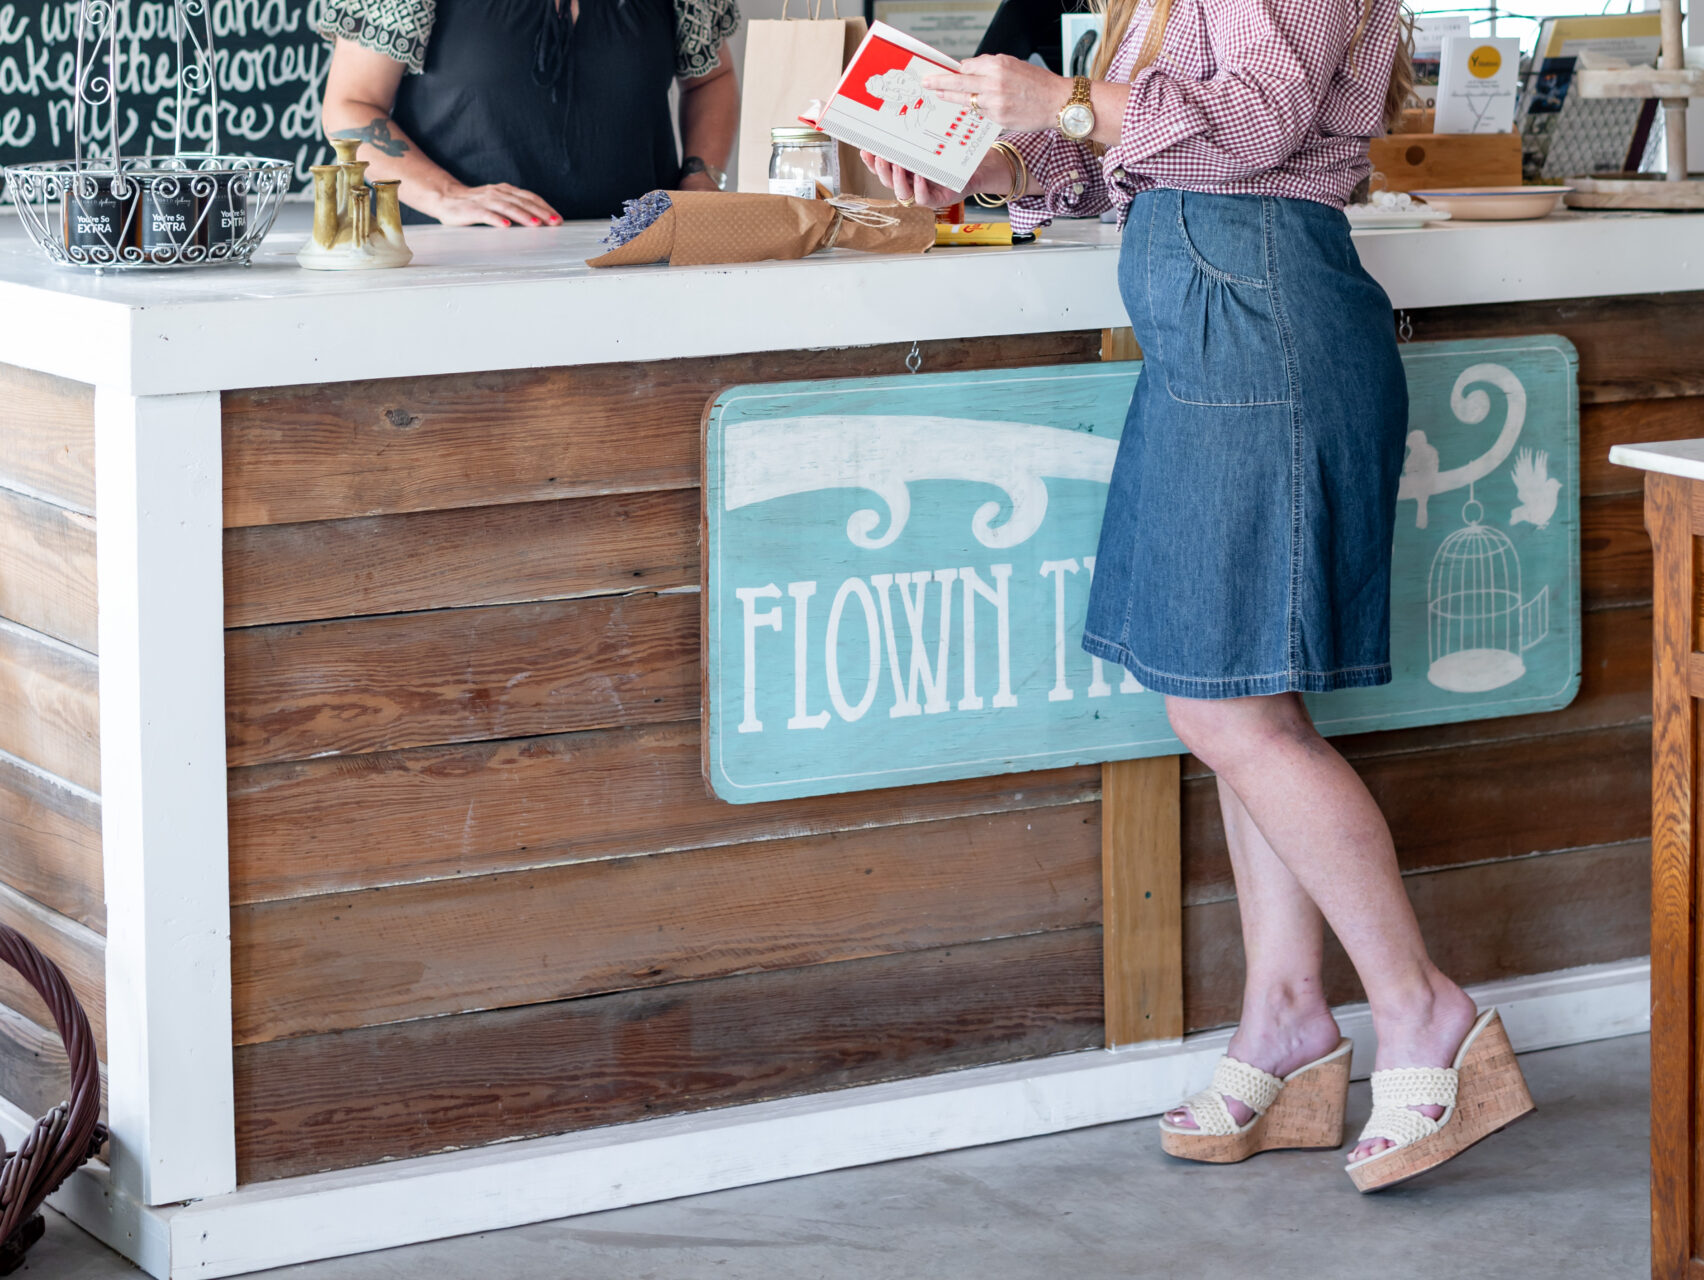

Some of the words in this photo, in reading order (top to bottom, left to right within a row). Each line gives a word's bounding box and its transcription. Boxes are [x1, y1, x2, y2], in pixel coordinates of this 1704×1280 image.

[102, 36, 179, 95] the
[150, 85, 274, 141] store
[100, 215, 110, 223] So
[152, 214, 174, 222] You're
[77, 223, 112, 234] EXTRA
[152, 221, 187, 232] EXTRA
[735, 563, 1019, 734] FLOWN
